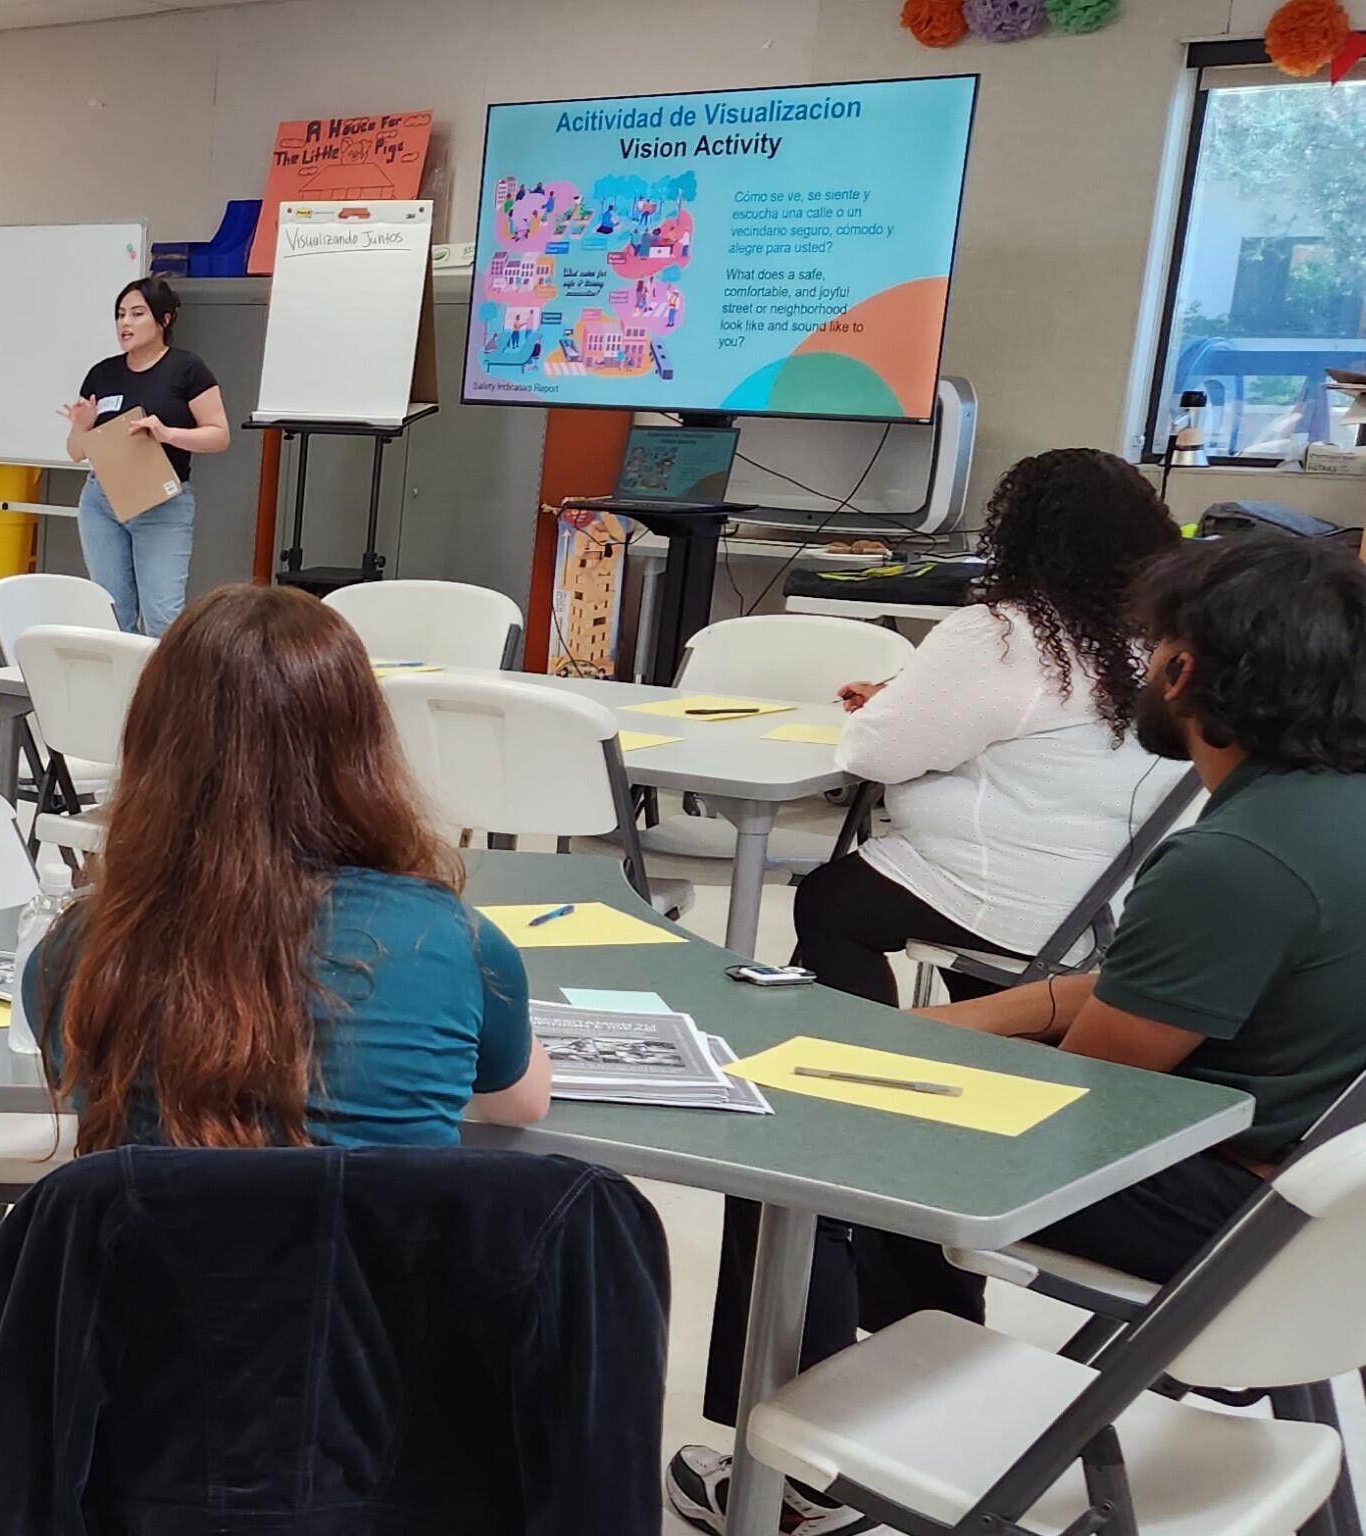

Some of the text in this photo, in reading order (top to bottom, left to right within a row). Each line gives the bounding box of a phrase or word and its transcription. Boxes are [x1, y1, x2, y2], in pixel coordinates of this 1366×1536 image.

[556, 97, 861, 132] Acitividad de Visualizacion
[306, 120, 321, 143] A
[381, 115, 403, 129] For
[620, 132, 782, 159] Vision Activity
[274, 151, 298, 166] The
[302, 144, 340, 165] Little
[770, 192, 784, 202] se
[787, 192, 804, 203] ve,
[807, 191, 822, 201] se
[825, 189, 860, 201] siente
[863, 190, 871, 202] y
[732, 207, 862, 220] escucha una calle o un
[731, 225, 787, 237] vecindario
[790, 226, 833, 238] seguro,
[887, 224, 894, 237] y
[286, 227, 404, 251] Visualizando Juntos
[728, 241, 833, 256] alegre para usted?
[726, 268, 825, 281] What does a safe,
[724, 286, 850, 300] comfortable, and joyful
[722, 303, 847, 317] street or neighborhood
[720, 320, 864, 333] look like and sound like to
[718, 336, 745, 349] you?
[533, 383, 559, 393] Report
